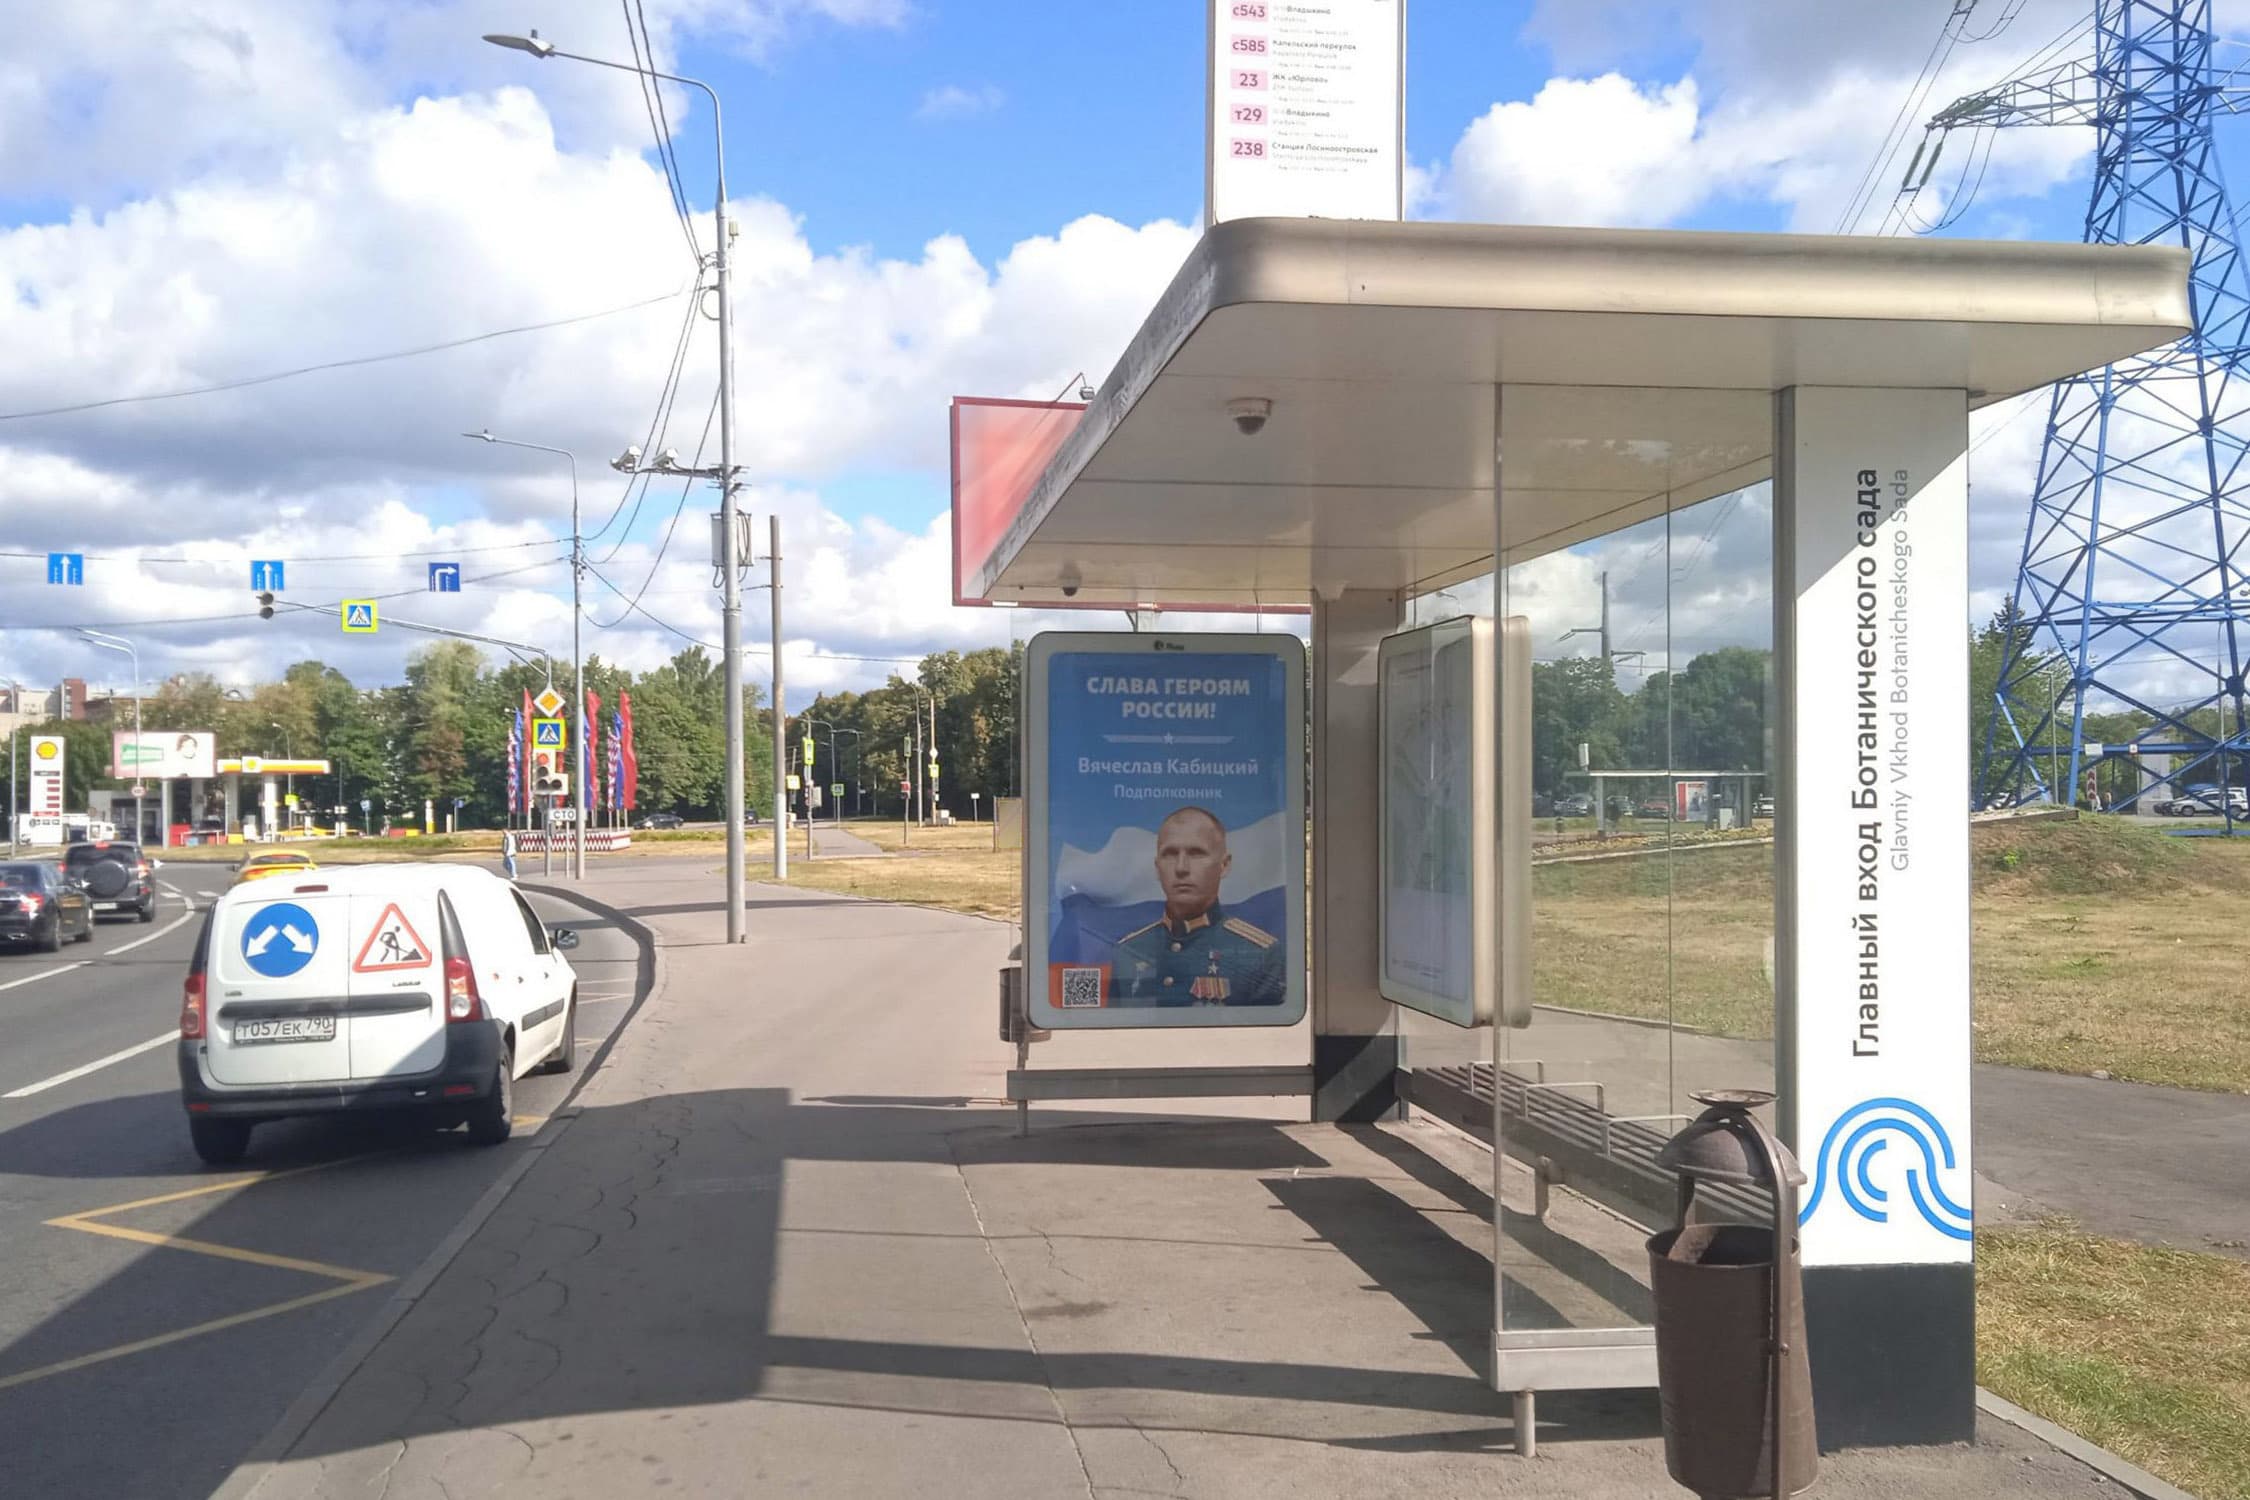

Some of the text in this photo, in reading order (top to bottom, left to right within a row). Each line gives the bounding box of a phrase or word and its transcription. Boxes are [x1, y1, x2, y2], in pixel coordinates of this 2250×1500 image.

[1232, 4, 1265, 18] с543
[1232, 39, 1265, 52] с585
[1239, 73, 1259, 87] 23
[1234, 107, 1262, 122] т29
[1234, 141, 1263, 156] 238
[1888, 469, 1912, 871] Glavniy Vkhod Botanicheskogo Sada
[1087, 676, 1251, 696] СЛАВА ГЕРОЯМ
[1122, 701, 1217, 719] РОССИИ!
[1078, 757, 1259, 777] Вячеслав Кабицкий
[1851, 469, 1882, 1057] Главный вход Ботанического сада
[1113, 784, 1223, 800] Подполковник
[553, 810, 576, 820] СТО
[305, 1015, 331, 1031] 790
